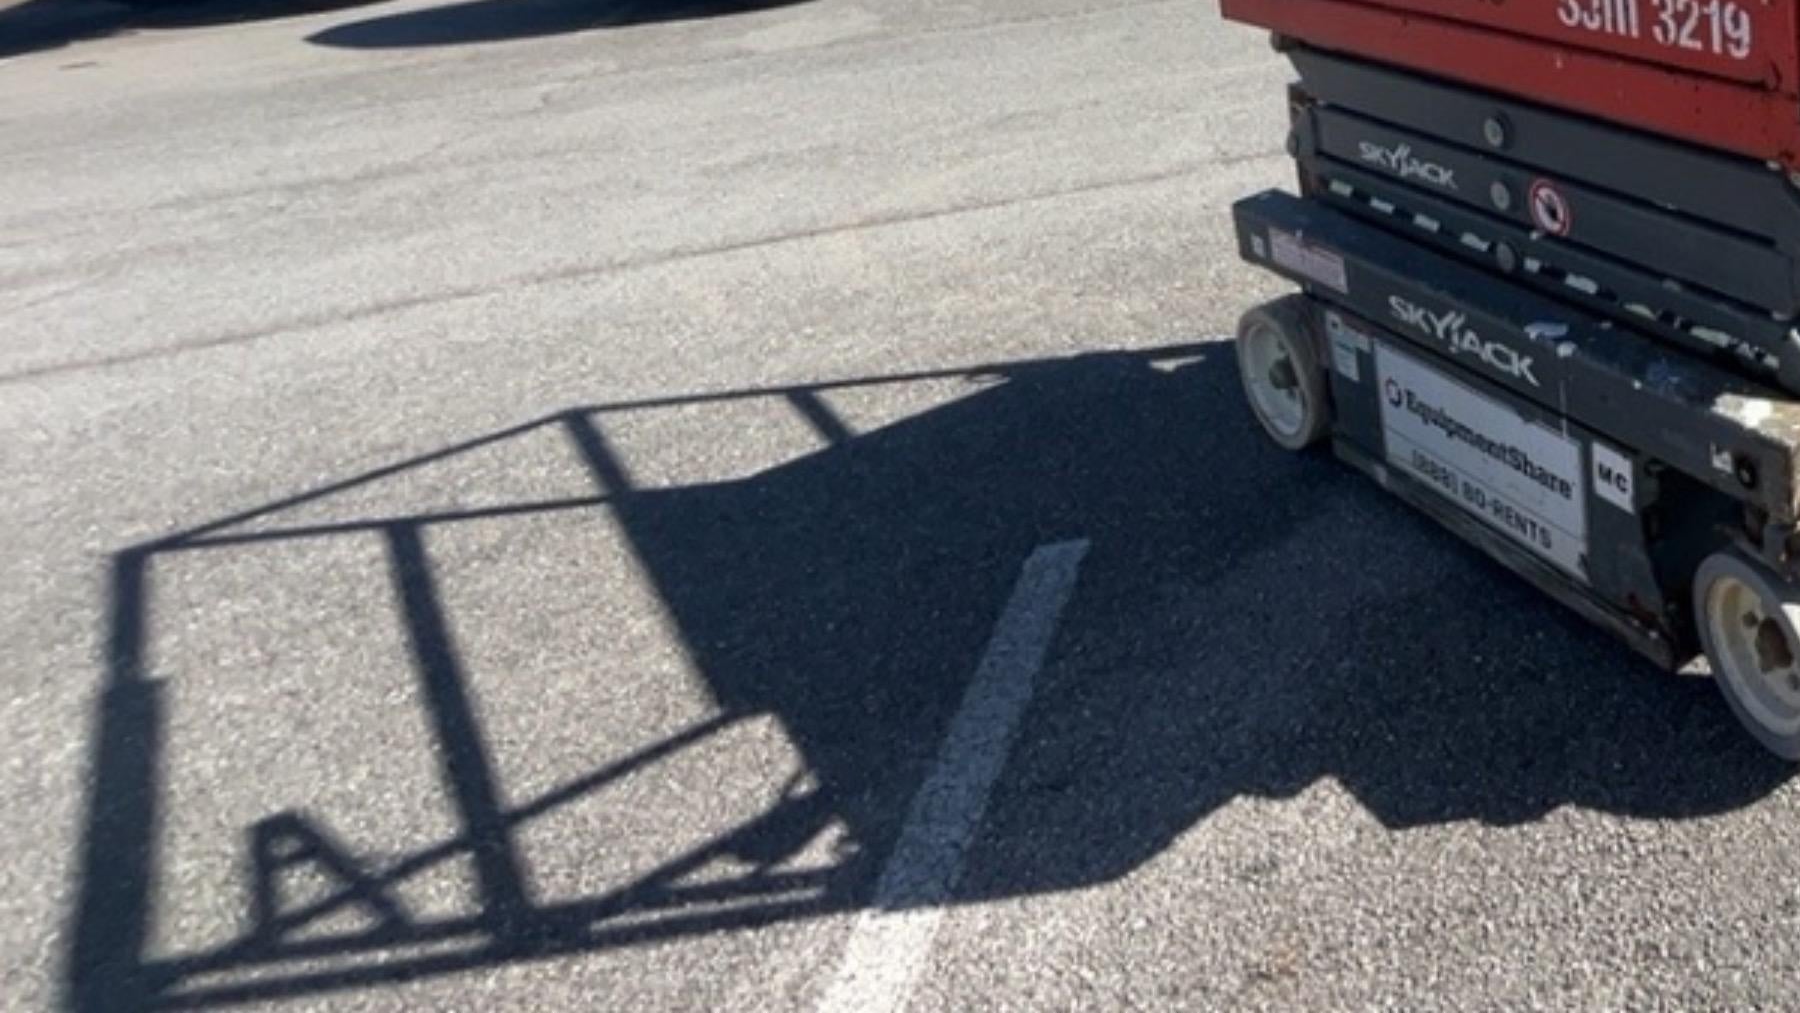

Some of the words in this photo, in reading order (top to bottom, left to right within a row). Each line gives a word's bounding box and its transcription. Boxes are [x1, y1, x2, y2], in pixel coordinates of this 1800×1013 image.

[1358, 139, 1459, 189] SKYJACK
[1388, 295, 1540, 386] SKYJACK
[1406, 389, 1573, 501] EquipmentShare
